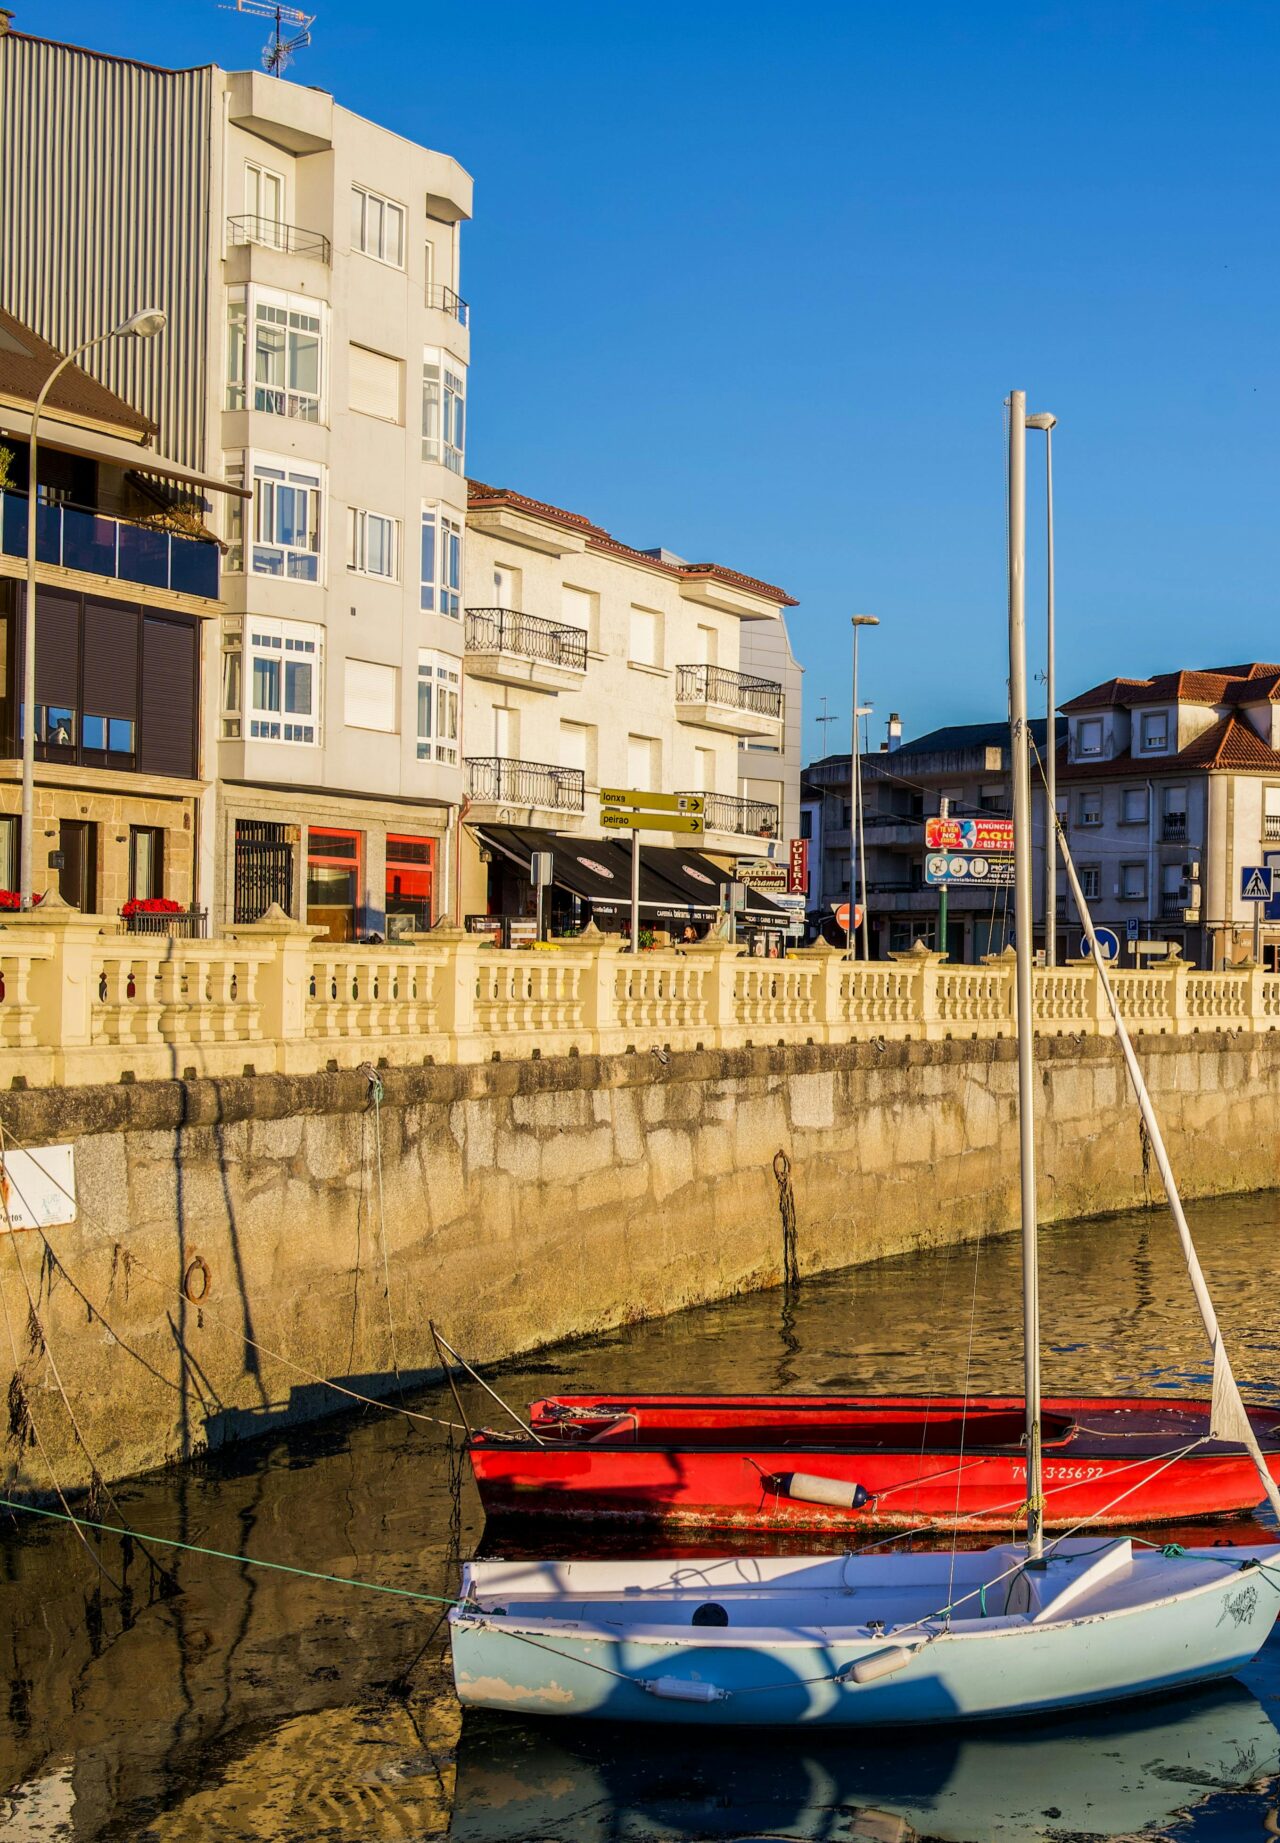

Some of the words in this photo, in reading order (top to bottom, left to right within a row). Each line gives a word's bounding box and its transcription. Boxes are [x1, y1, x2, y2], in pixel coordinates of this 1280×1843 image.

[603, 793, 626, 802] lonxa
[603, 815, 629, 825] peirao
[979, 832, 1013, 840] AQU
[792, 841, 803, 890] PULPERIA
[741, 877, 785, 887] Beiramar
[1130, 921, 1135, 929] P
